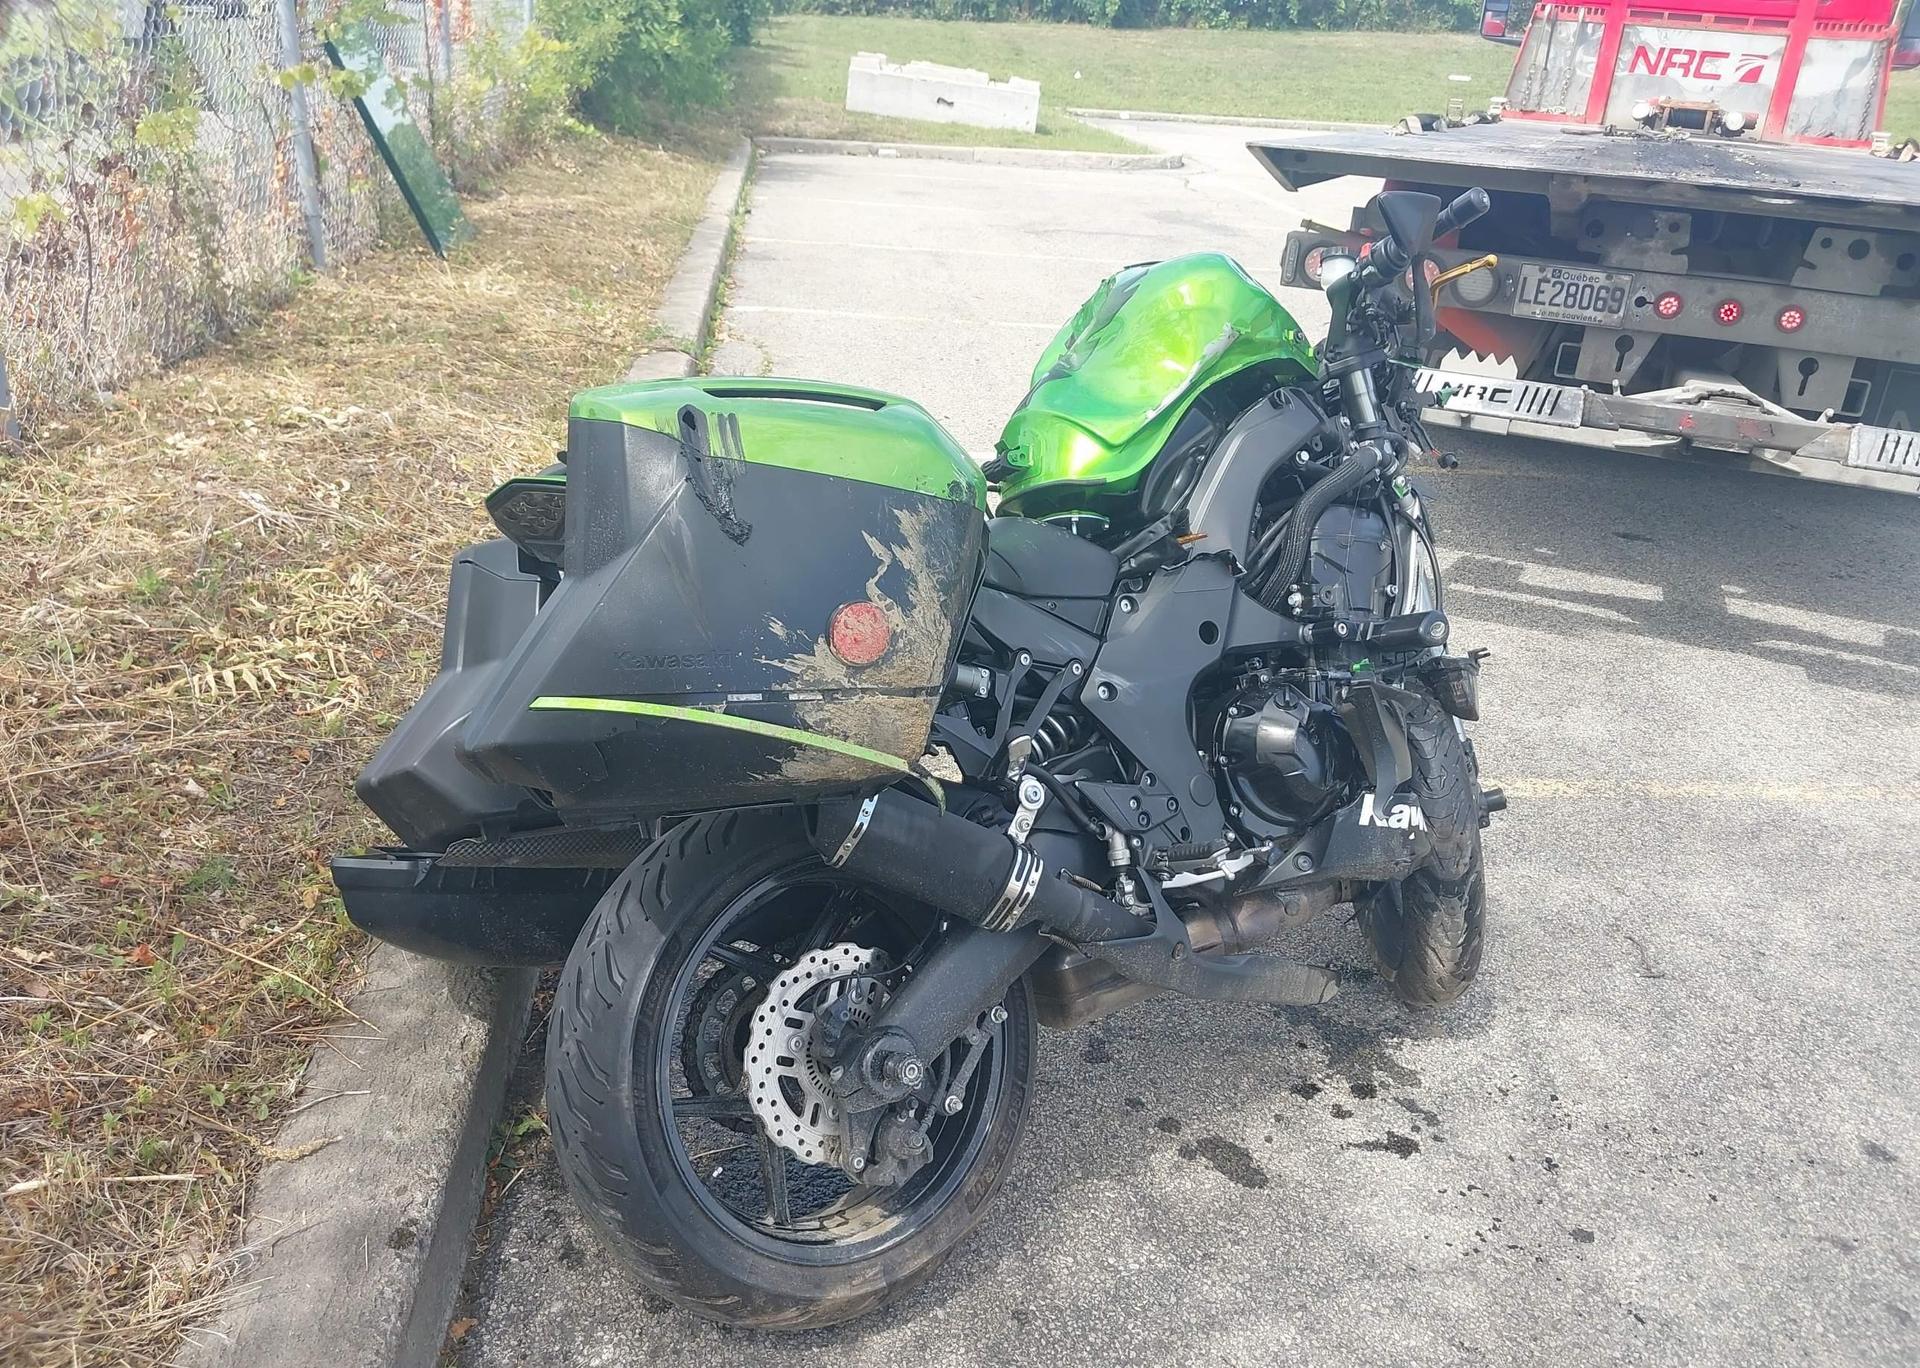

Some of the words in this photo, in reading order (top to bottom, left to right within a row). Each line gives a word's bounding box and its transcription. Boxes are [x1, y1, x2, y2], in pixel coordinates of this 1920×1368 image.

[1628, 45, 1731, 81] NRC
[1562, 270, 1600, 284] Québec
[1518, 275, 1626, 315] LE28069
[1536, 309, 1546, 318] Je
[1547, 310, 1560, 318] me
[1561, 311, 1599, 323] souviens
